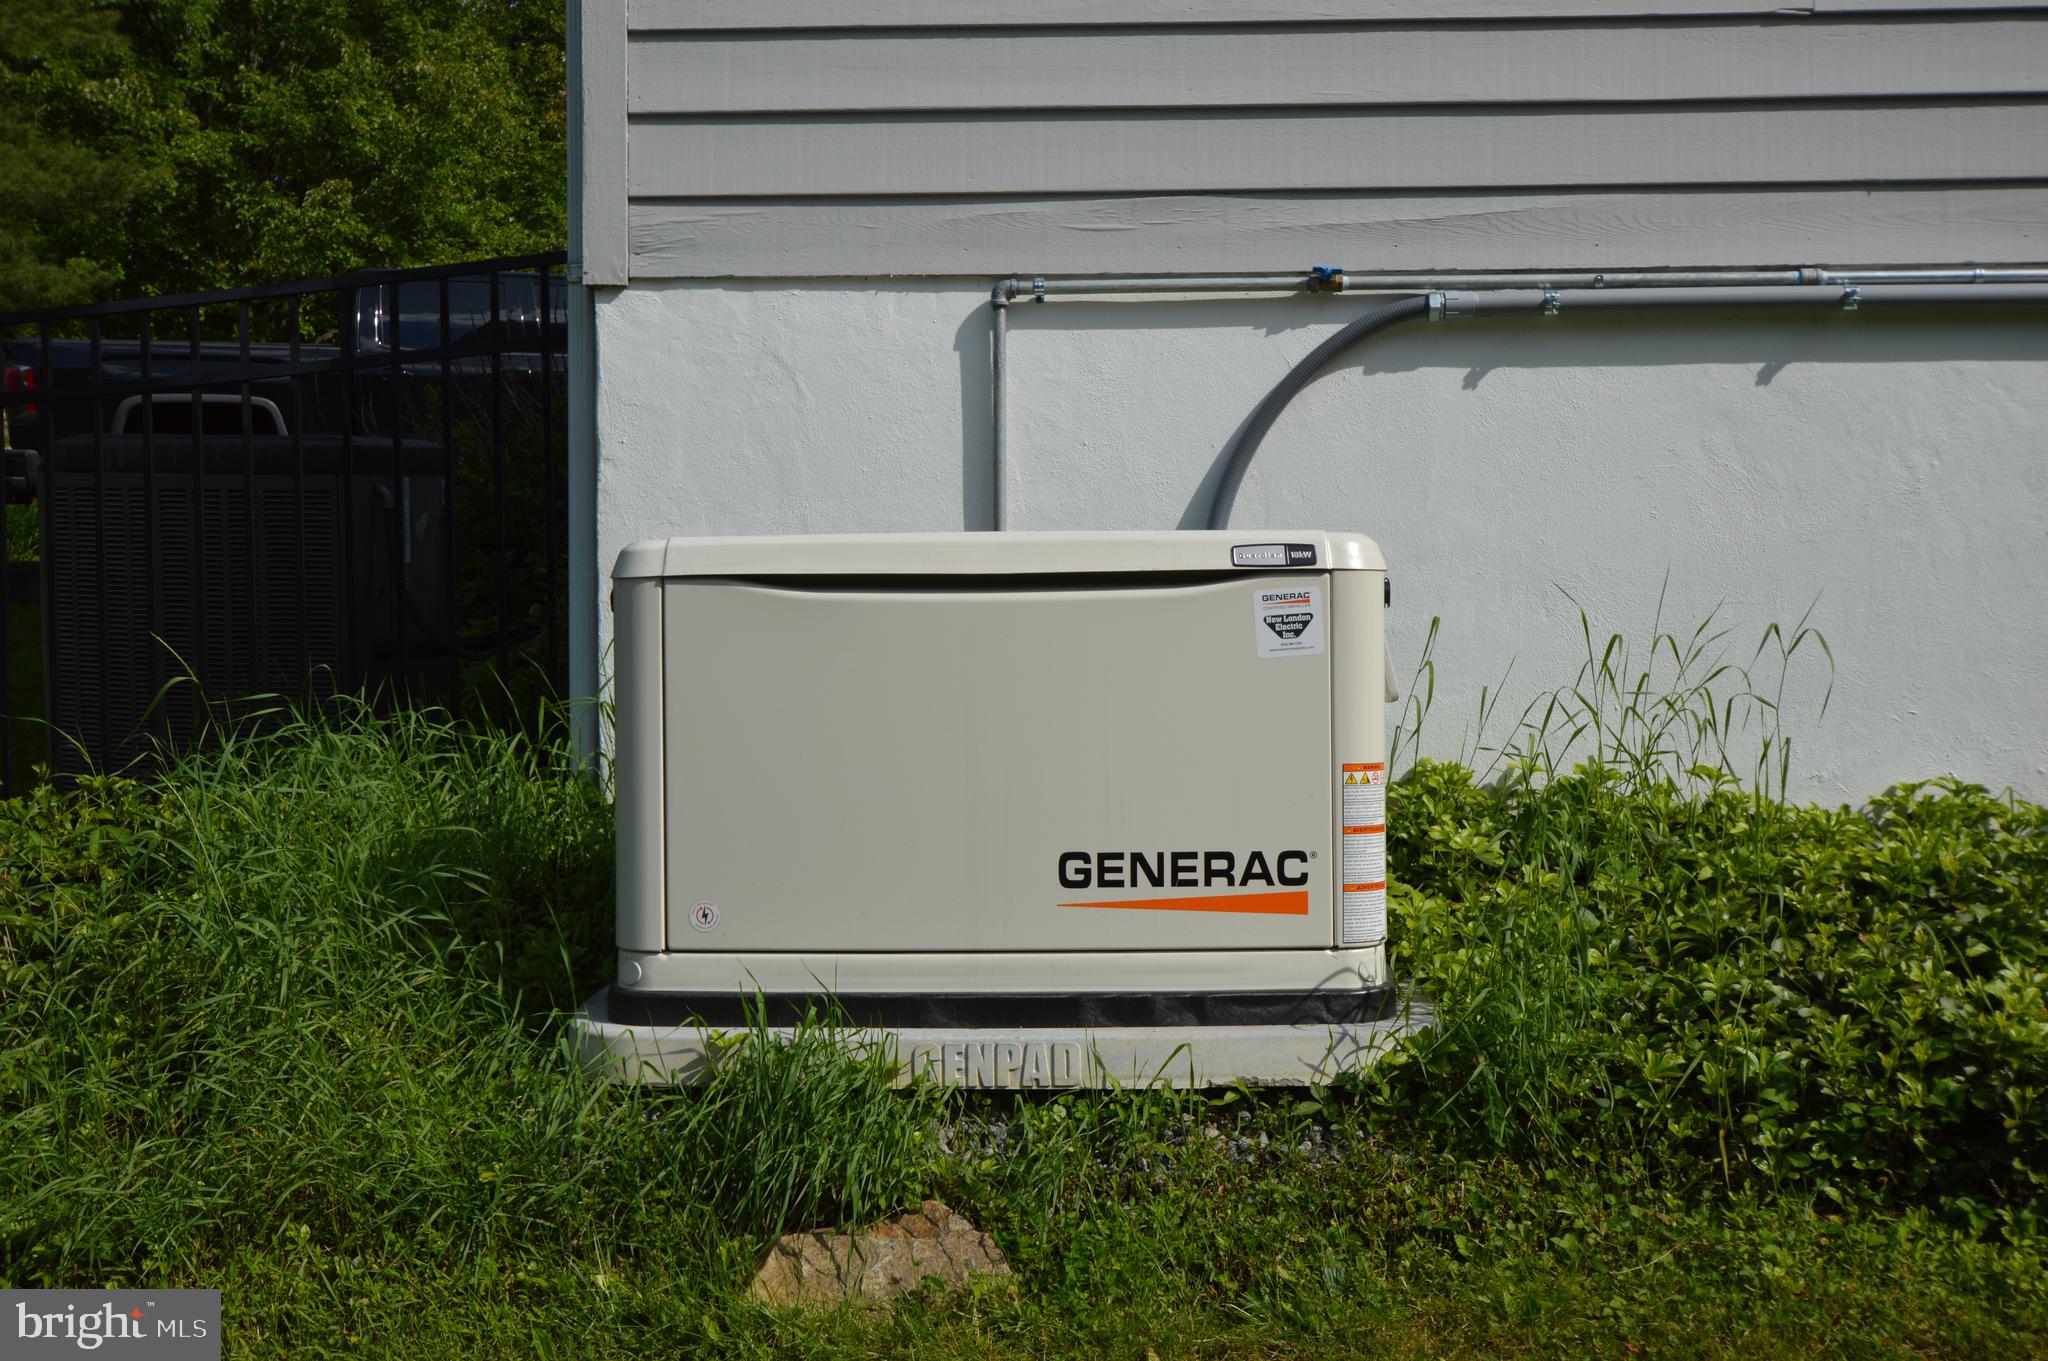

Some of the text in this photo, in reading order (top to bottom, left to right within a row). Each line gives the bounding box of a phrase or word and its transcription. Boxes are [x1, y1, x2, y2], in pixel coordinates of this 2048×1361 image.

[1290, 551, 1312, 559] 18kW
[1262, 592, 1310, 602] GENERAC
[1266, 613, 1311, 623] New London
[1275, 622, 1303, 631] Electric
[1282, 630, 1297, 639] Inc.
[1058, 850, 1309, 889] GENERAC
[910, 1042, 1081, 1089] GENPAD
